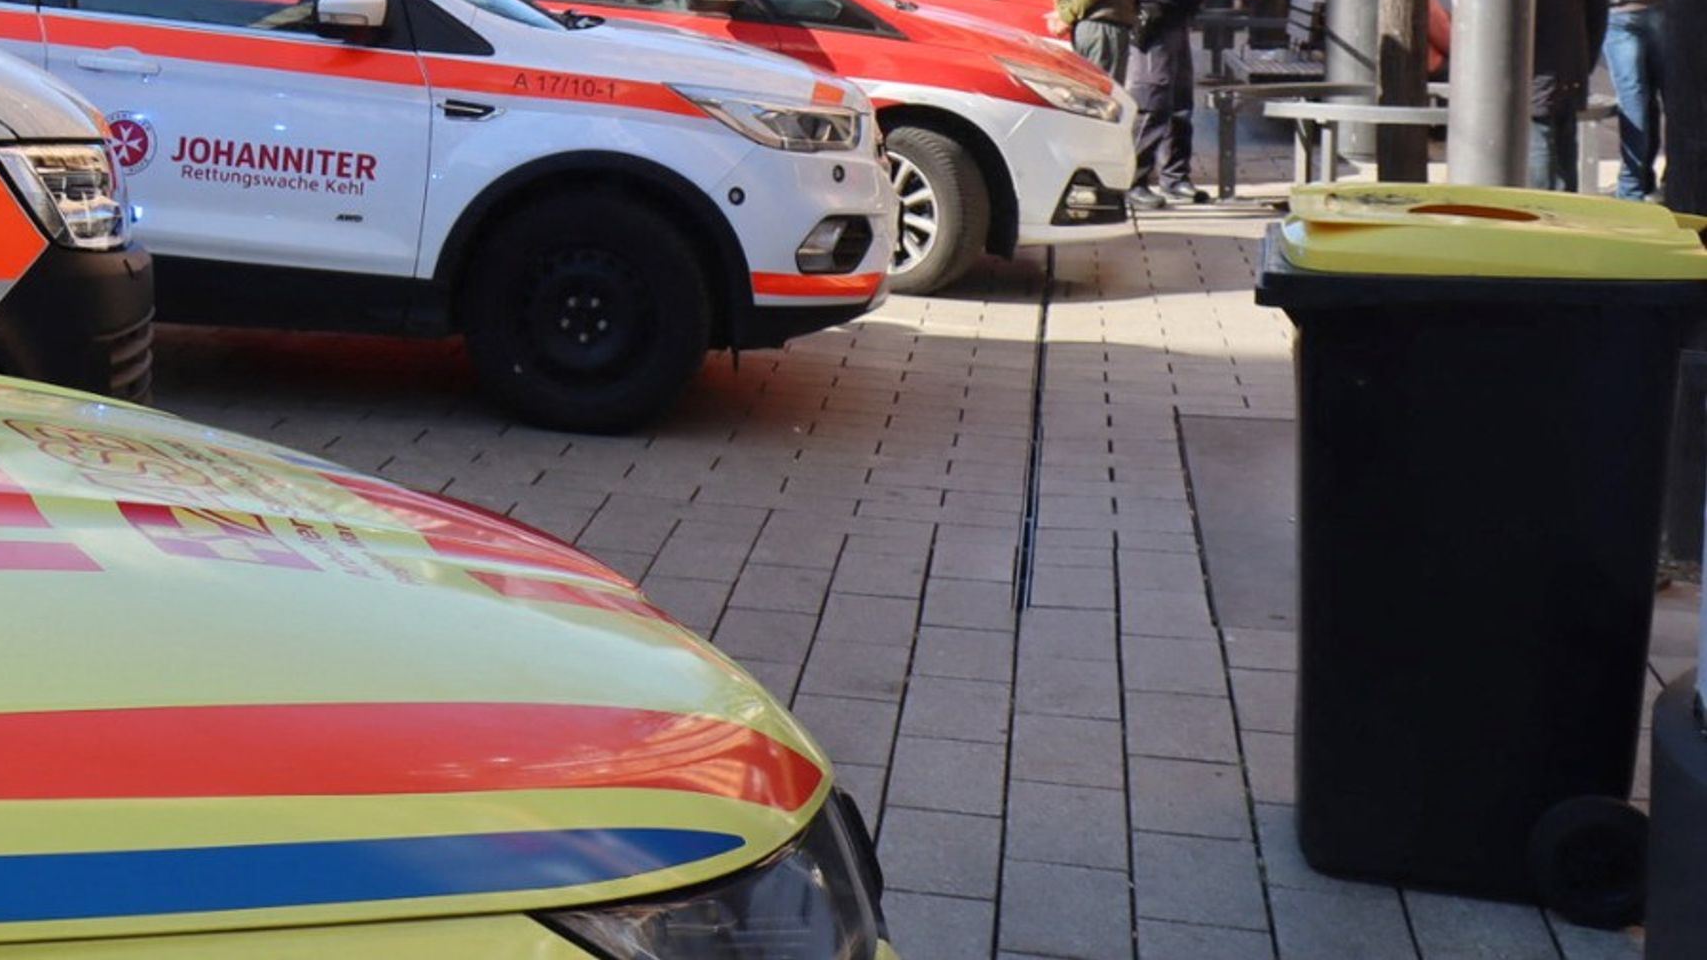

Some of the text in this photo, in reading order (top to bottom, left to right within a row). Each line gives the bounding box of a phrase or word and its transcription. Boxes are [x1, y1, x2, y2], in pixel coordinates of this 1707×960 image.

[512, 72, 615, 100] A 17/10-1
[171, 136, 377, 181] JOHANNITER
[181, 164, 365, 196] Rettungswache Kehl
